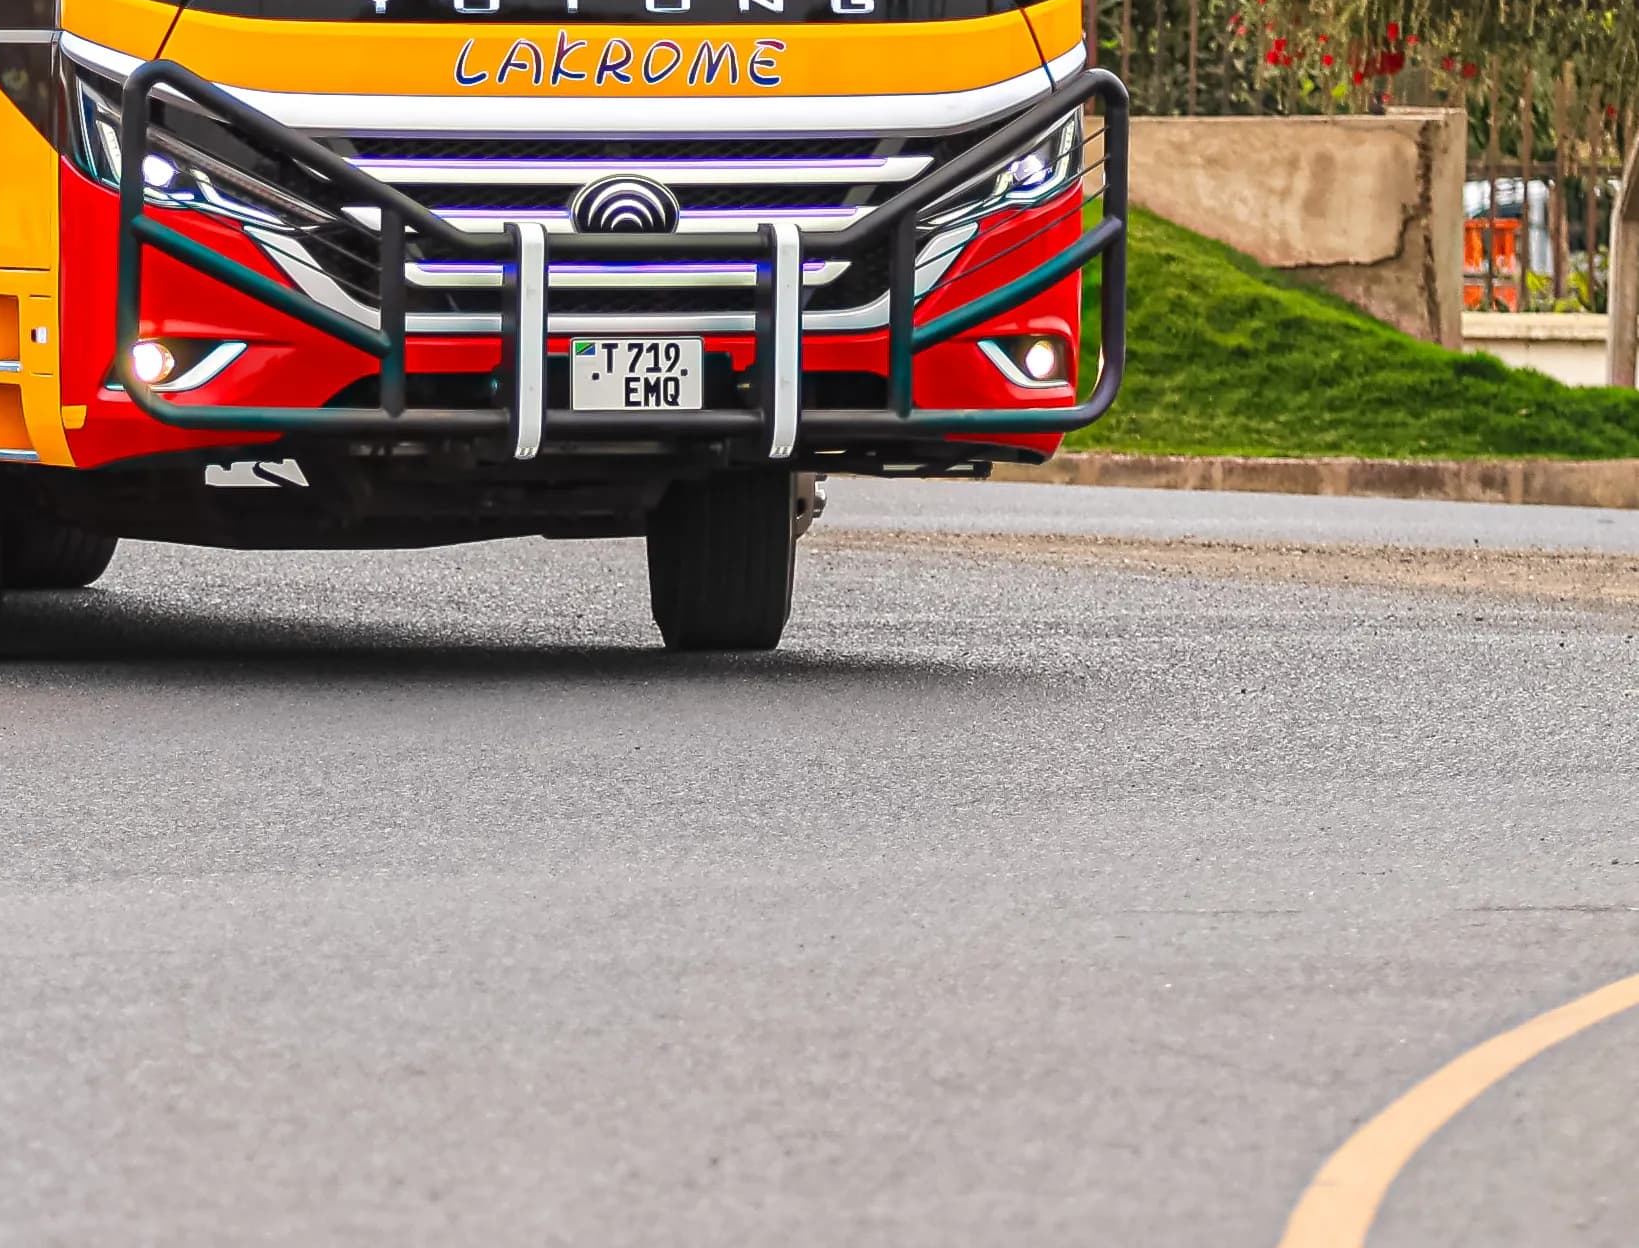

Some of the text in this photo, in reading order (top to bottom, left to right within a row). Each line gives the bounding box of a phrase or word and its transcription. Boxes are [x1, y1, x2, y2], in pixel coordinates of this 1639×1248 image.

[453, 29, 785, 87] LAKROME
[601, 342, 681, 374] T 719
[624, 376, 680, 407] EMQ
